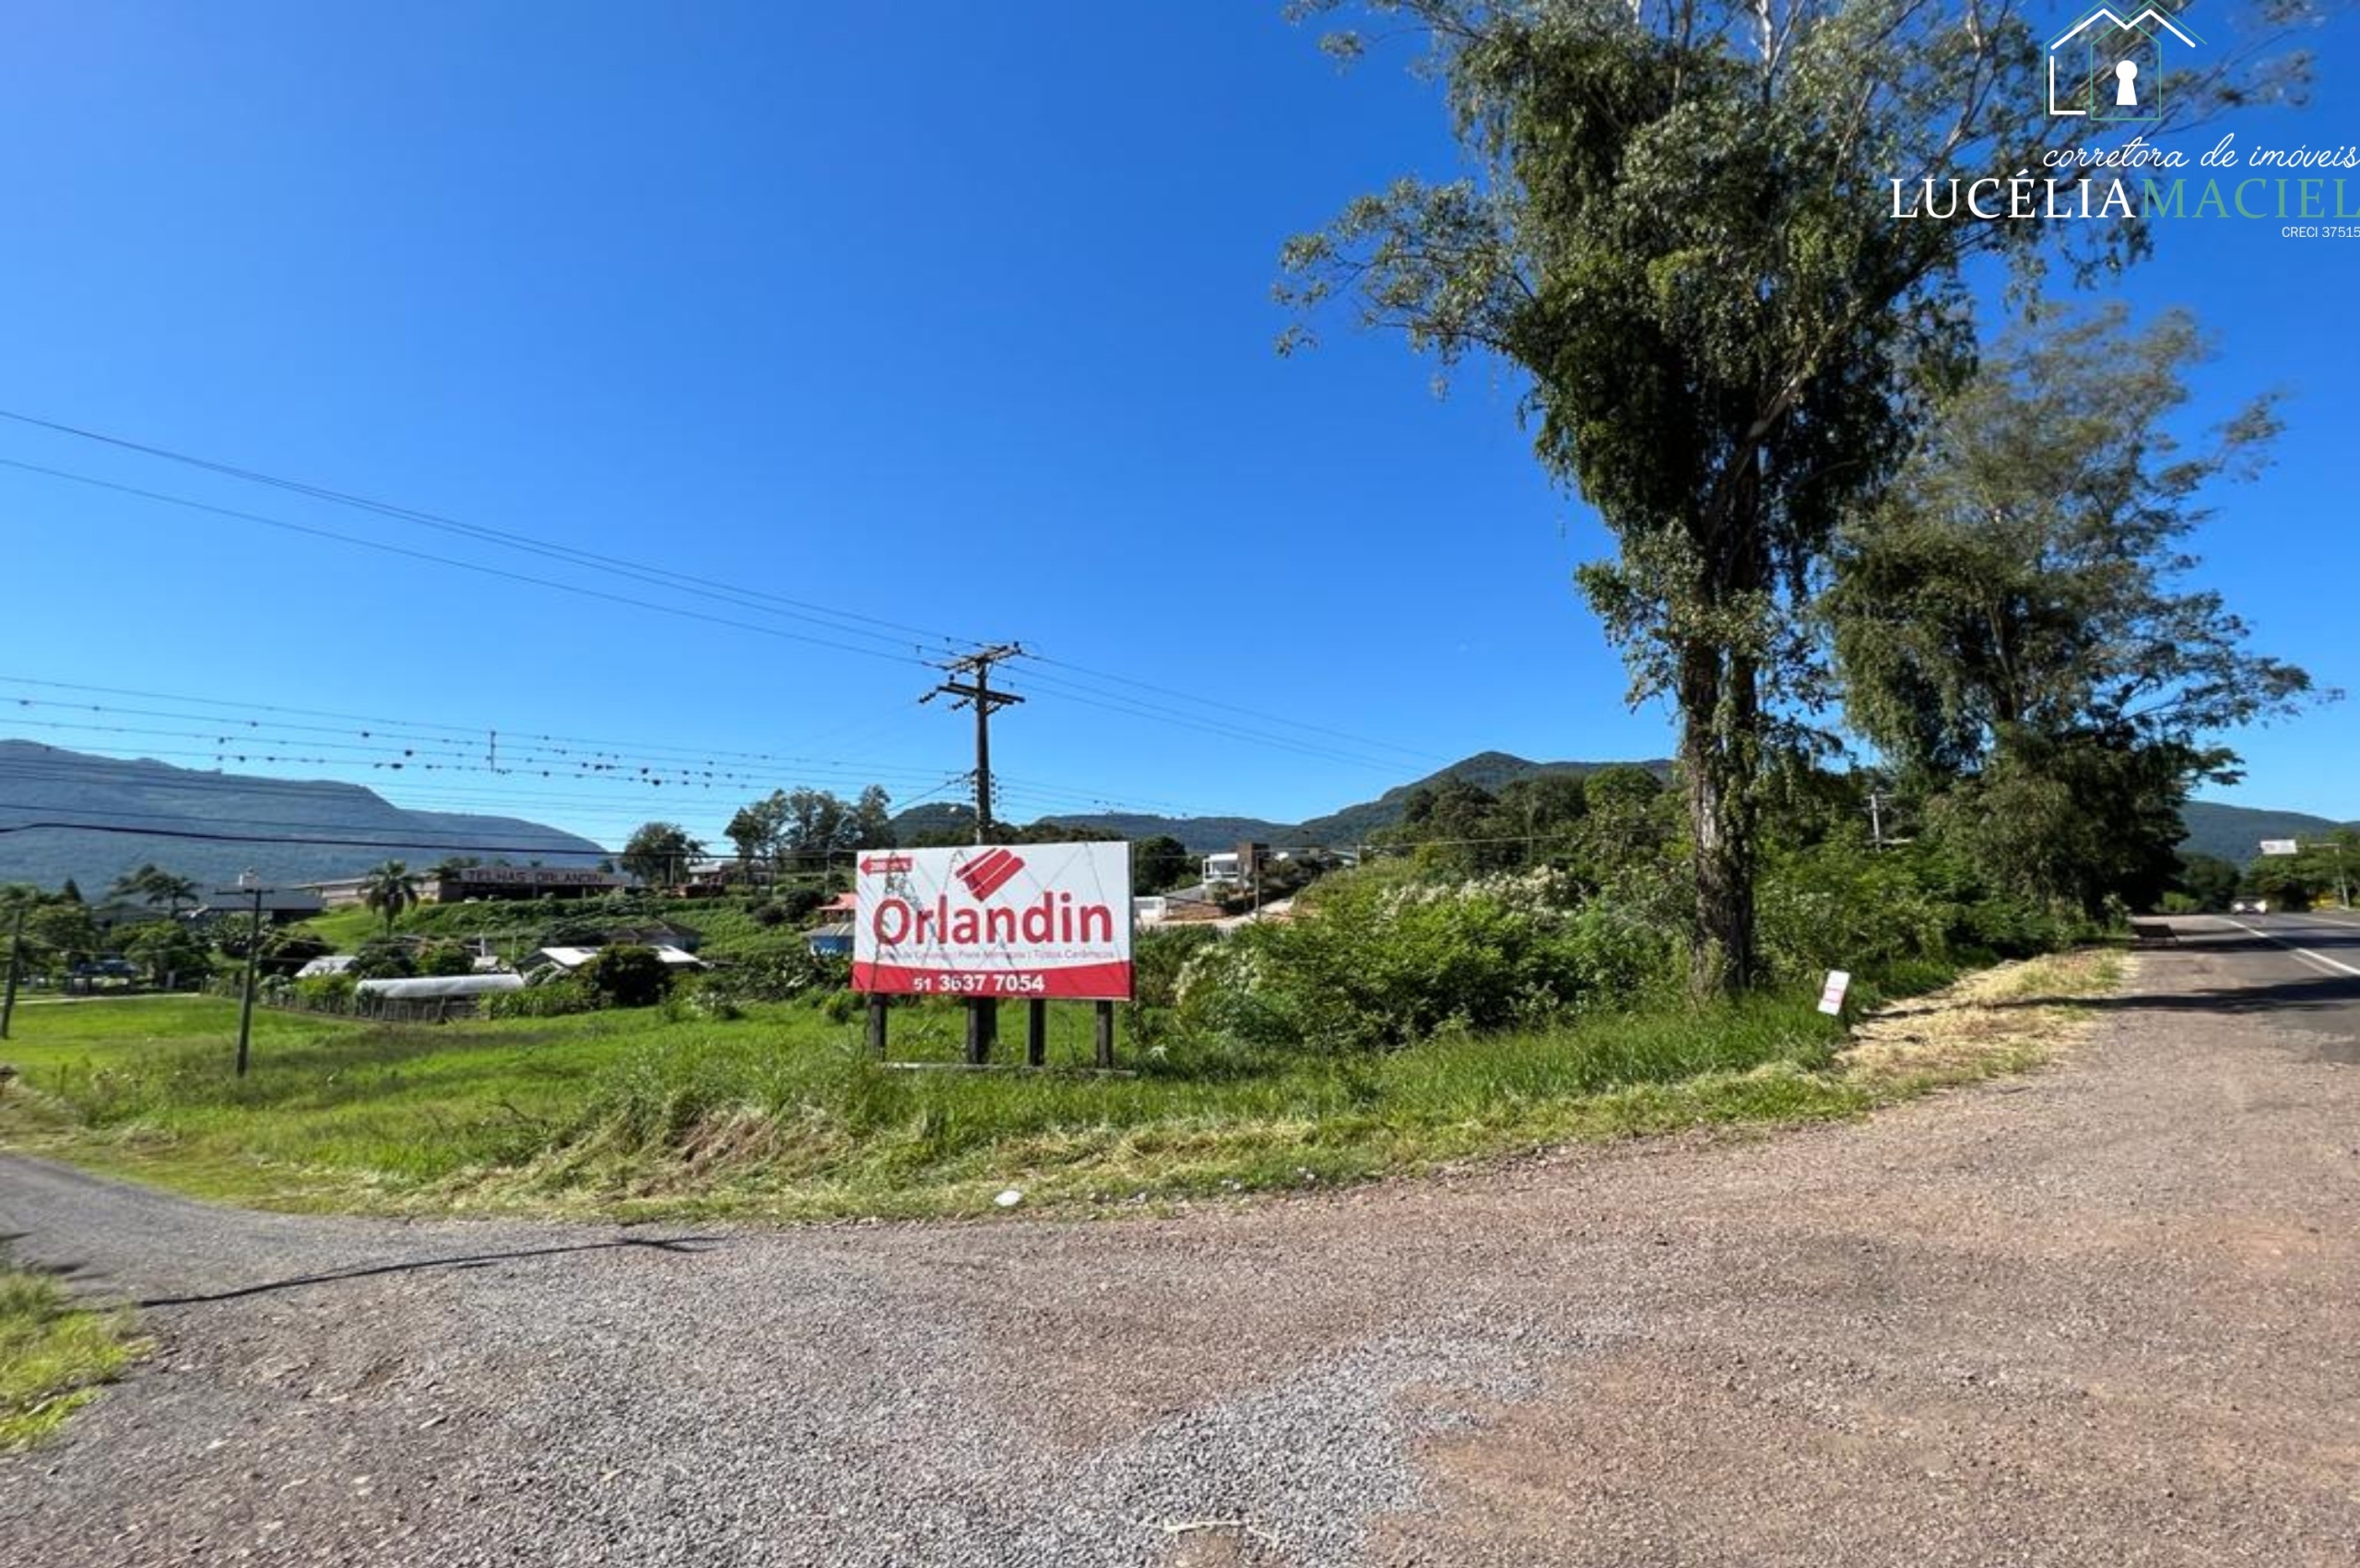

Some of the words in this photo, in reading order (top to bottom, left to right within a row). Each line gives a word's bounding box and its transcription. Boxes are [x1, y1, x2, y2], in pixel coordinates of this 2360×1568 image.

[872, 890, 1114, 946] Orlandin
[913, 978, 931, 991] 51
[939, 974, 985, 992] 3637
[993, 974, 1045, 992] 7054
